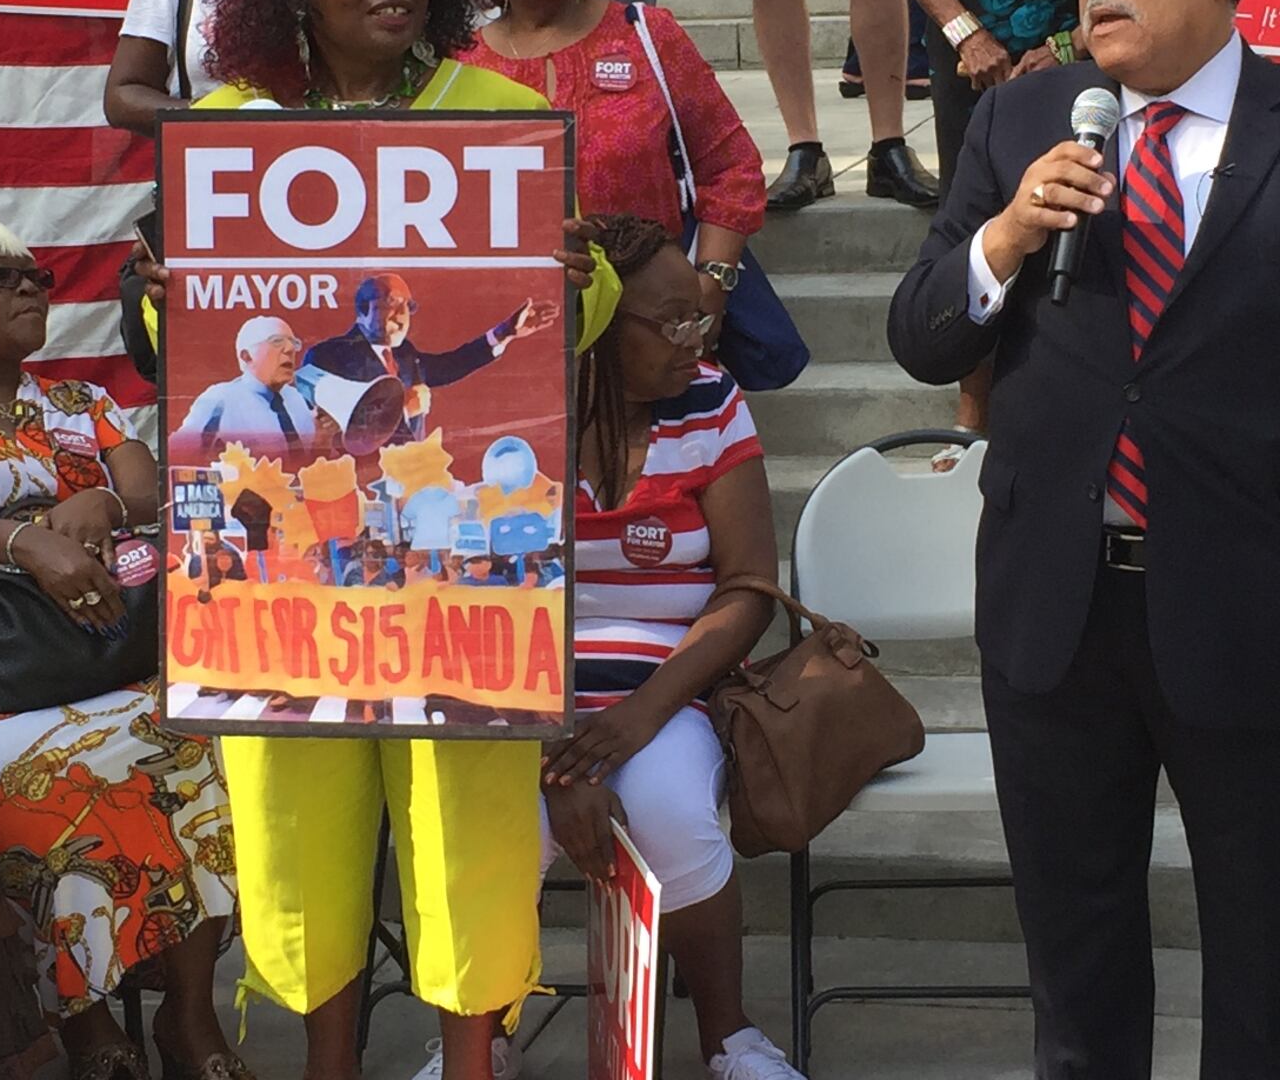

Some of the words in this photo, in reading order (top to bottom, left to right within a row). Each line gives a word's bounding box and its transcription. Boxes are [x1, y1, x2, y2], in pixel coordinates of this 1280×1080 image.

[595, 62, 632, 73] FORT
[184, 144, 545, 250] FORT
[185, 273, 339, 310] MAYOR
[626, 524, 667, 541] FORT
[117, 543, 148, 566] ORT
[253, 596, 321, 680] FOR
[328, 600, 410, 686] $15
[421, 596, 515, 691] AND
[523, 606, 563, 696] A
